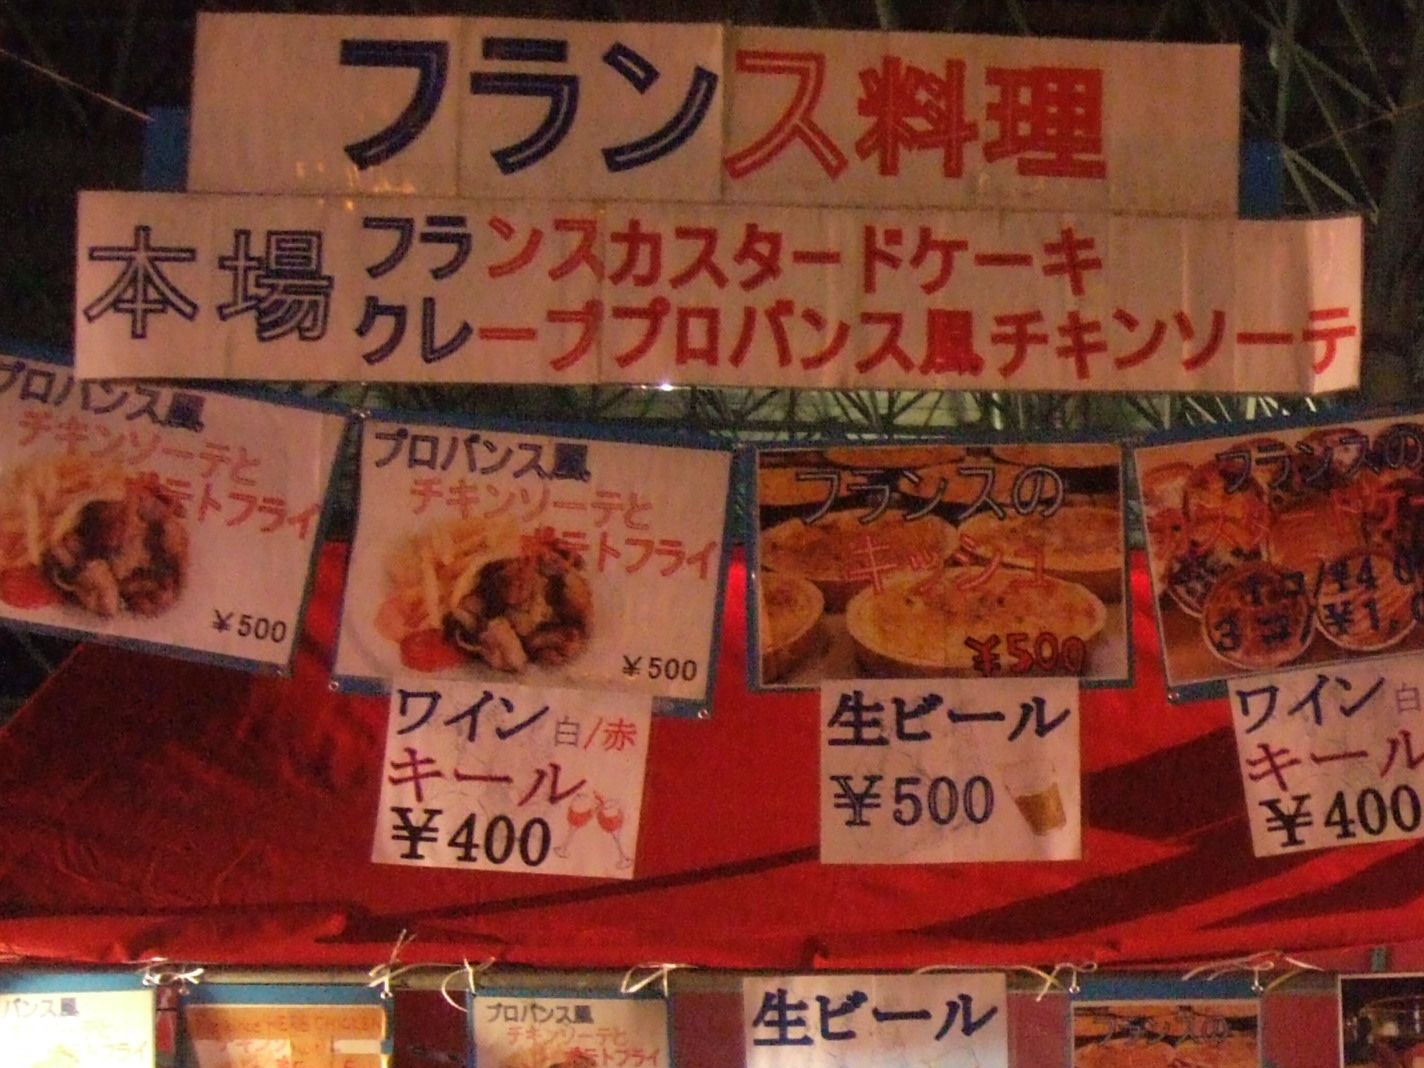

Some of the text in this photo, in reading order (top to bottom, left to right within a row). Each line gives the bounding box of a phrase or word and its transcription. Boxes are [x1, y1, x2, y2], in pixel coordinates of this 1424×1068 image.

[340, 37, 1107, 180] フランス料理
[83, 224, 335, 342] 本場
[361, 214, 1104, 296] フランスカスタードケーキ
[354, 297, 1356, 380] クレーププロバンス風チキンソーテ
[409, 476, 654, 532] チキンソーテと
[794, 464, 1065, 525] フランスの
[844, 535, 1060, 594] キッシュ
[212, 609, 288, 643] ¥500
[964, 632, 1088, 677] ¥500
[622, 655, 698, 682] ¥500
[395, 688, 638, 751] ワイン 白/赤
[827, 690, 1072, 747] 生ビール
[1235, 673, 1386, 735] ワイン
[387, 747, 588, 807] キール
[830, 773, 996, 828] ¥500
[389, 806, 553, 868] ¥400
[1259, 783, 1423, 849] ¥400
[751, 988, 999, 1048] 生ビール
